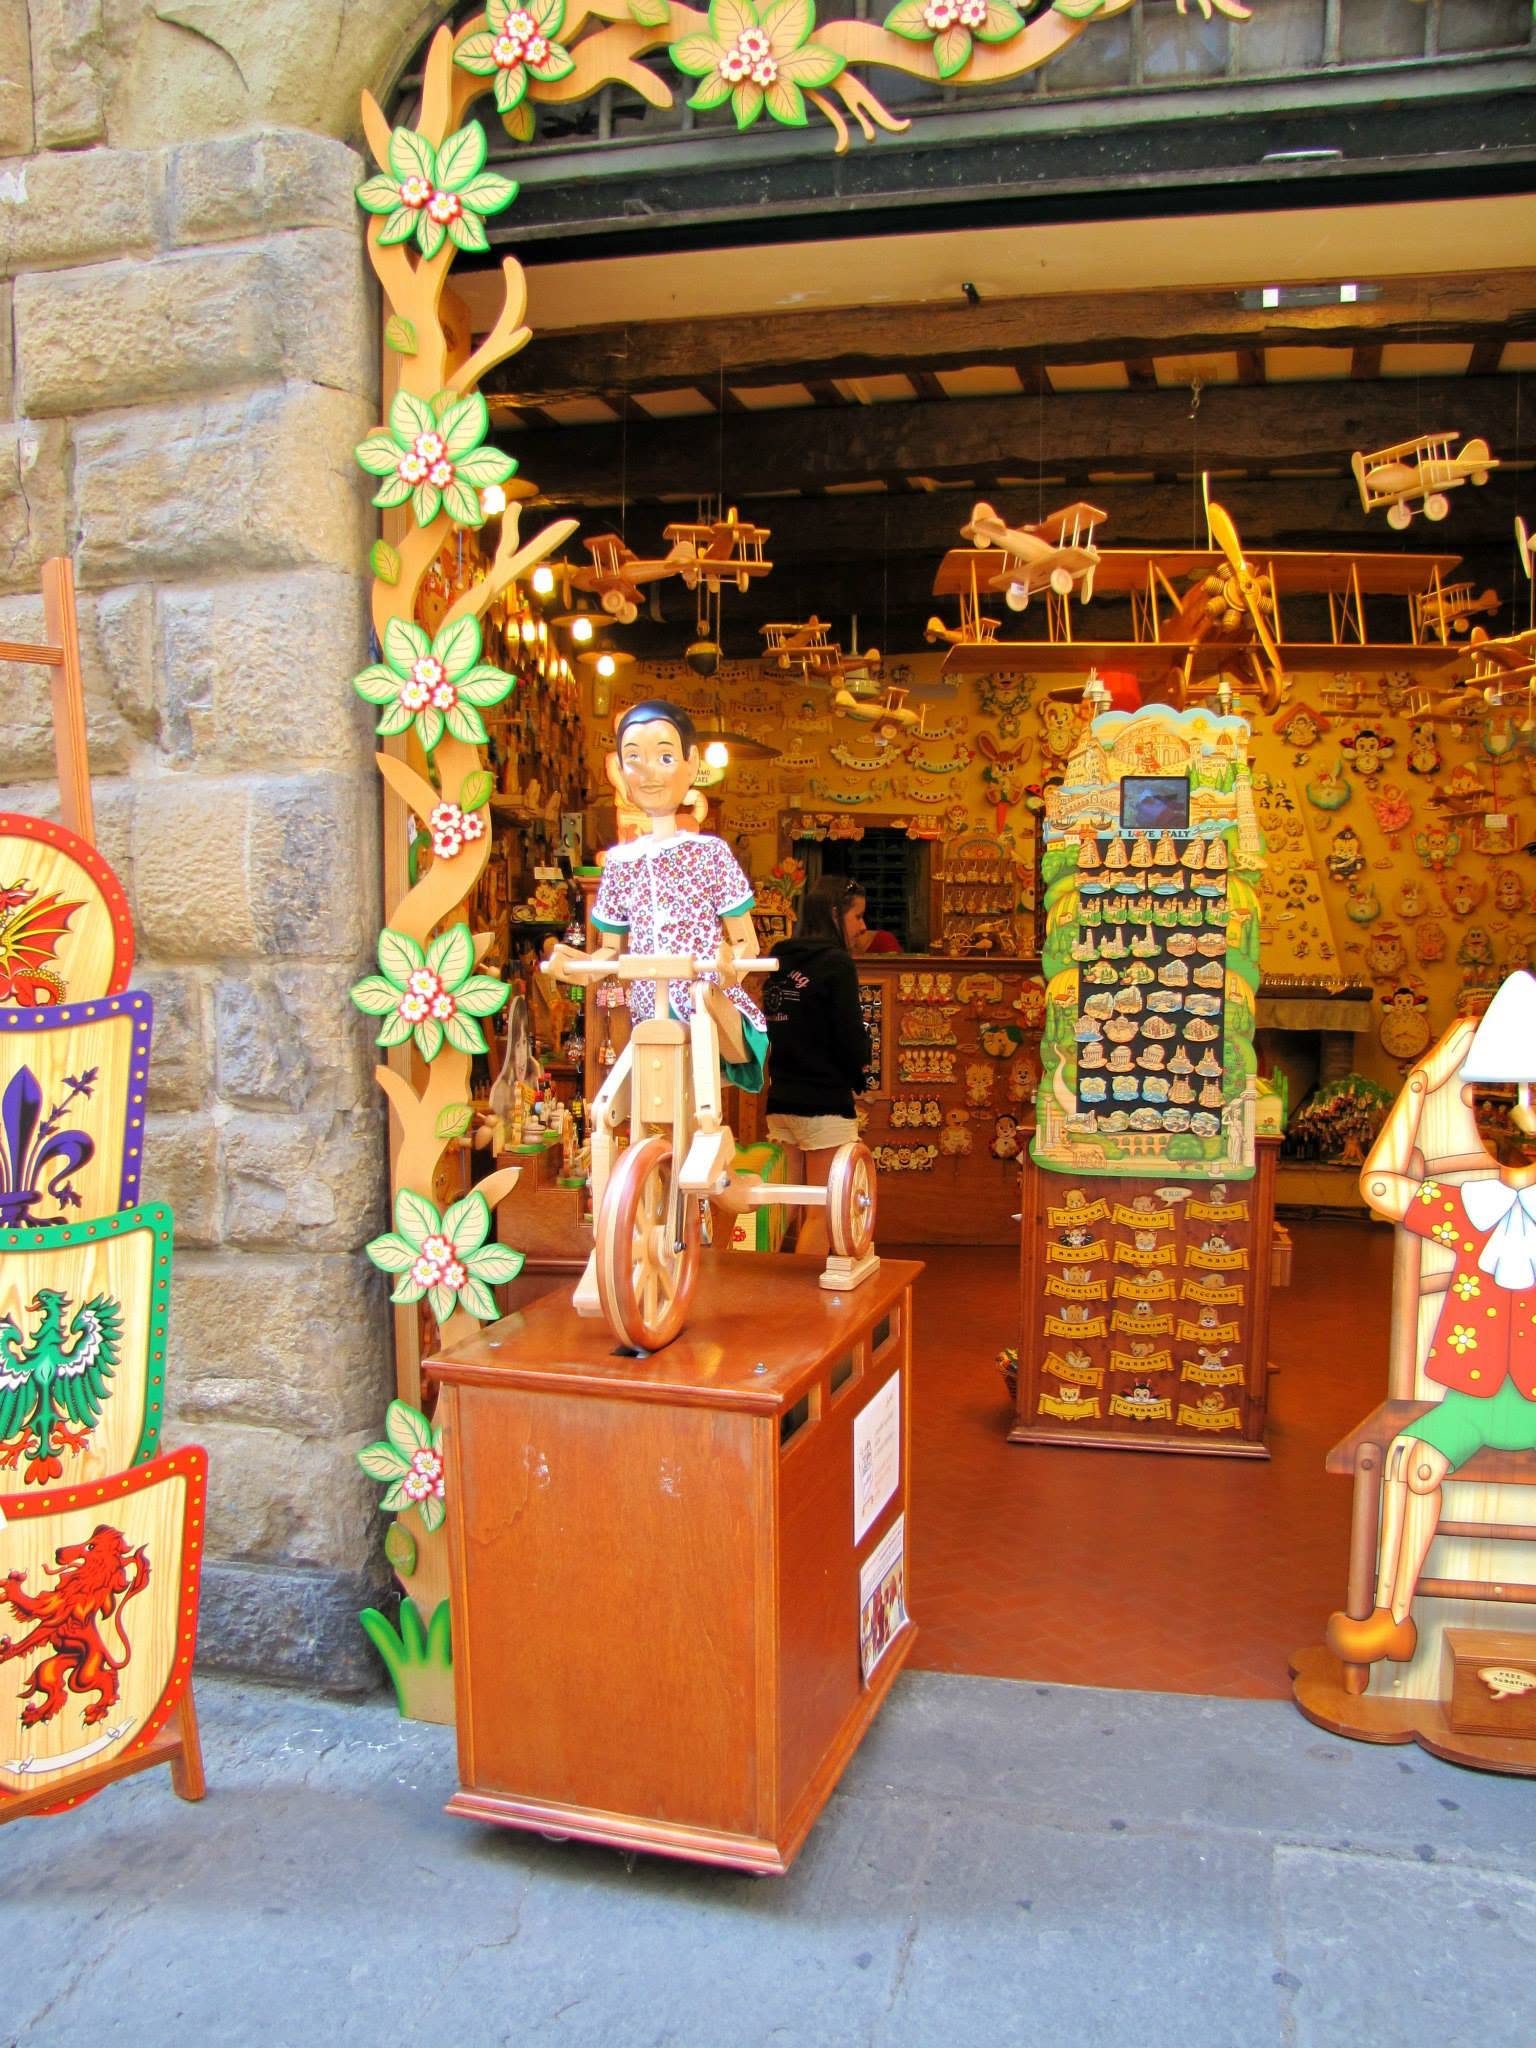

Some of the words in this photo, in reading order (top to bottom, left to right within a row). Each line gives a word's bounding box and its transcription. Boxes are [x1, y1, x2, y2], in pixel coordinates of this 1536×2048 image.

[1124, 1251, 1166, 1259] DANIEL
[1054, 1284, 1099, 1294] MICHELLE
[1126, 1287, 1164, 1295] LUCIA
[1117, 1320, 1168, 1329] VALENTINA
[1189, 1370, 1235, 1379] WILLIAM
